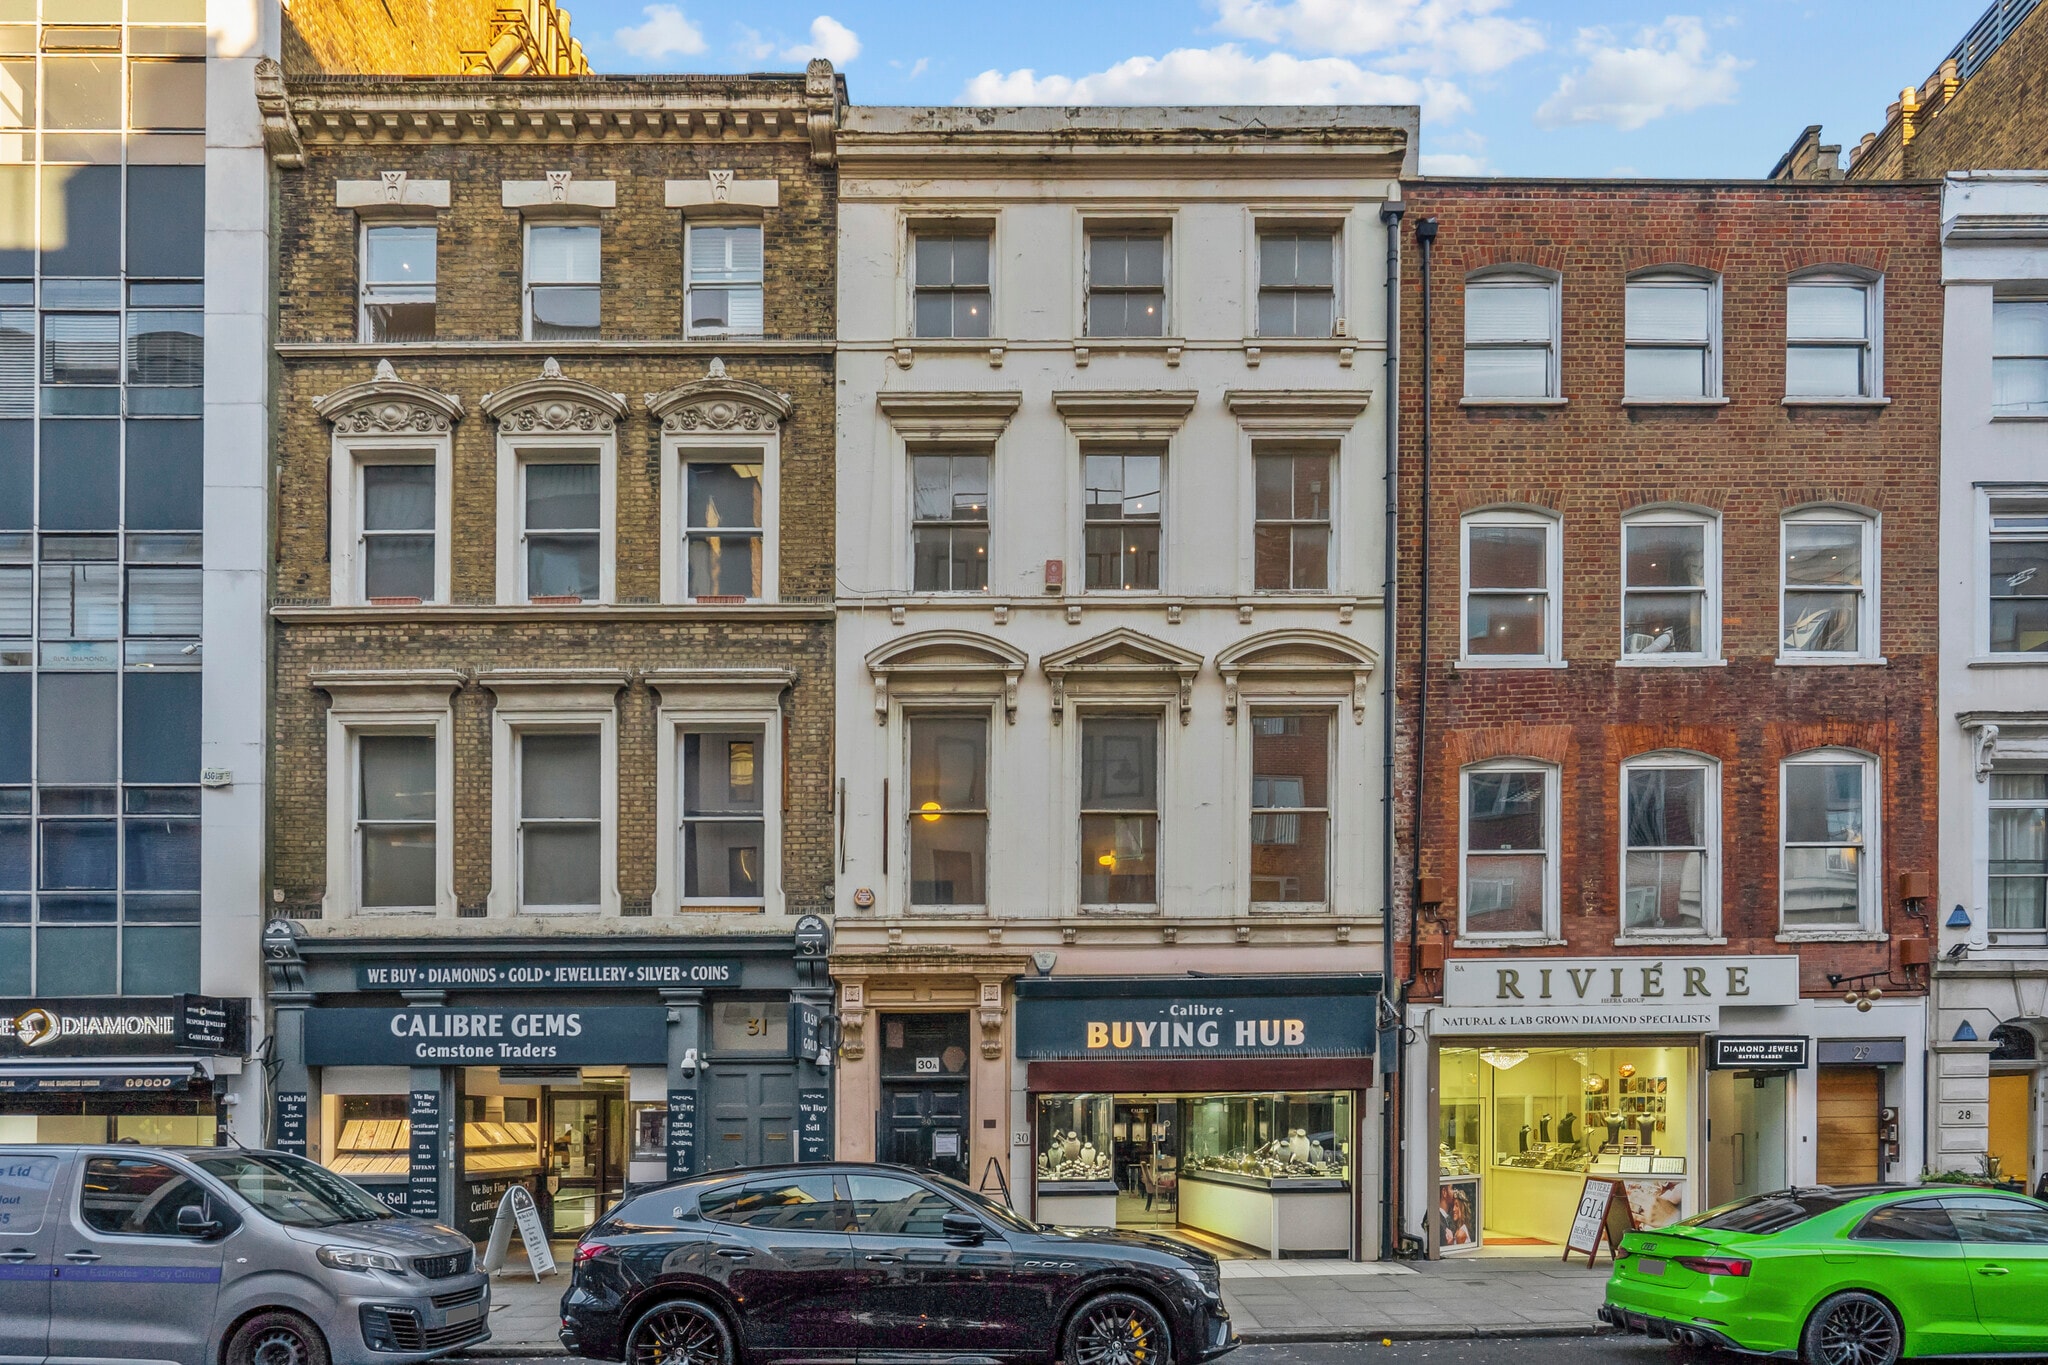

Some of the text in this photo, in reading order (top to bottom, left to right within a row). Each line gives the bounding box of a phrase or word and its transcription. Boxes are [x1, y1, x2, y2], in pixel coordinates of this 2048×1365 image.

[270, 944, 290, 959] 31
[803, 940, 820, 955] 31
[367, 965, 729, 983] WE BUY DIAMONDS GOLD JEWELLERY SILVER COINS
[1496, 961, 1750, 999] RIVIÉRE
[1169, 1004, 1224, 1016] Calibre
[390, 1013, 582, 1037] CALIBRE GEMS
[803, 1011, 818, 1027] CASH
[1442, 1014, 1711, 1027] NATURAL & LAB GROWN DIAMOND SPECIALISTS
[746, 1018, 768, 1036] 31
[1087, 1019, 1305, 1048] BUYING HUB
[415, 1042, 557, 1058] Gemstone Traders
[803, 1037, 818, 1051] GOLD
[1723, 1045, 1798, 1053] DIAMOND JEWELS
[1852, 1045, 1871, 1060] 29
[918, 1060, 937, 1070] 30A
[411, 1107, 438, 1115] Jewellery
[812, 1104, 828, 1113] Buy
[1958, 1110, 1971, 1120] 28
[810, 1113, 817, 1121] &
[805, 1123, 820, 1131] Sell
[1015, 1132, 1029, 1144] 30
[8, 1166, 32, 1177] Ltd
[471, 1185, 481, 1195] We
[482, 1184, 493, 1196] Buy
[494, 1182, 506, 1193] Fine
[387, 1192, 407, 1205] Sell
[1579, 1197, 1605, 1220] GIA
[153, 1269, 170, 1280] Key
